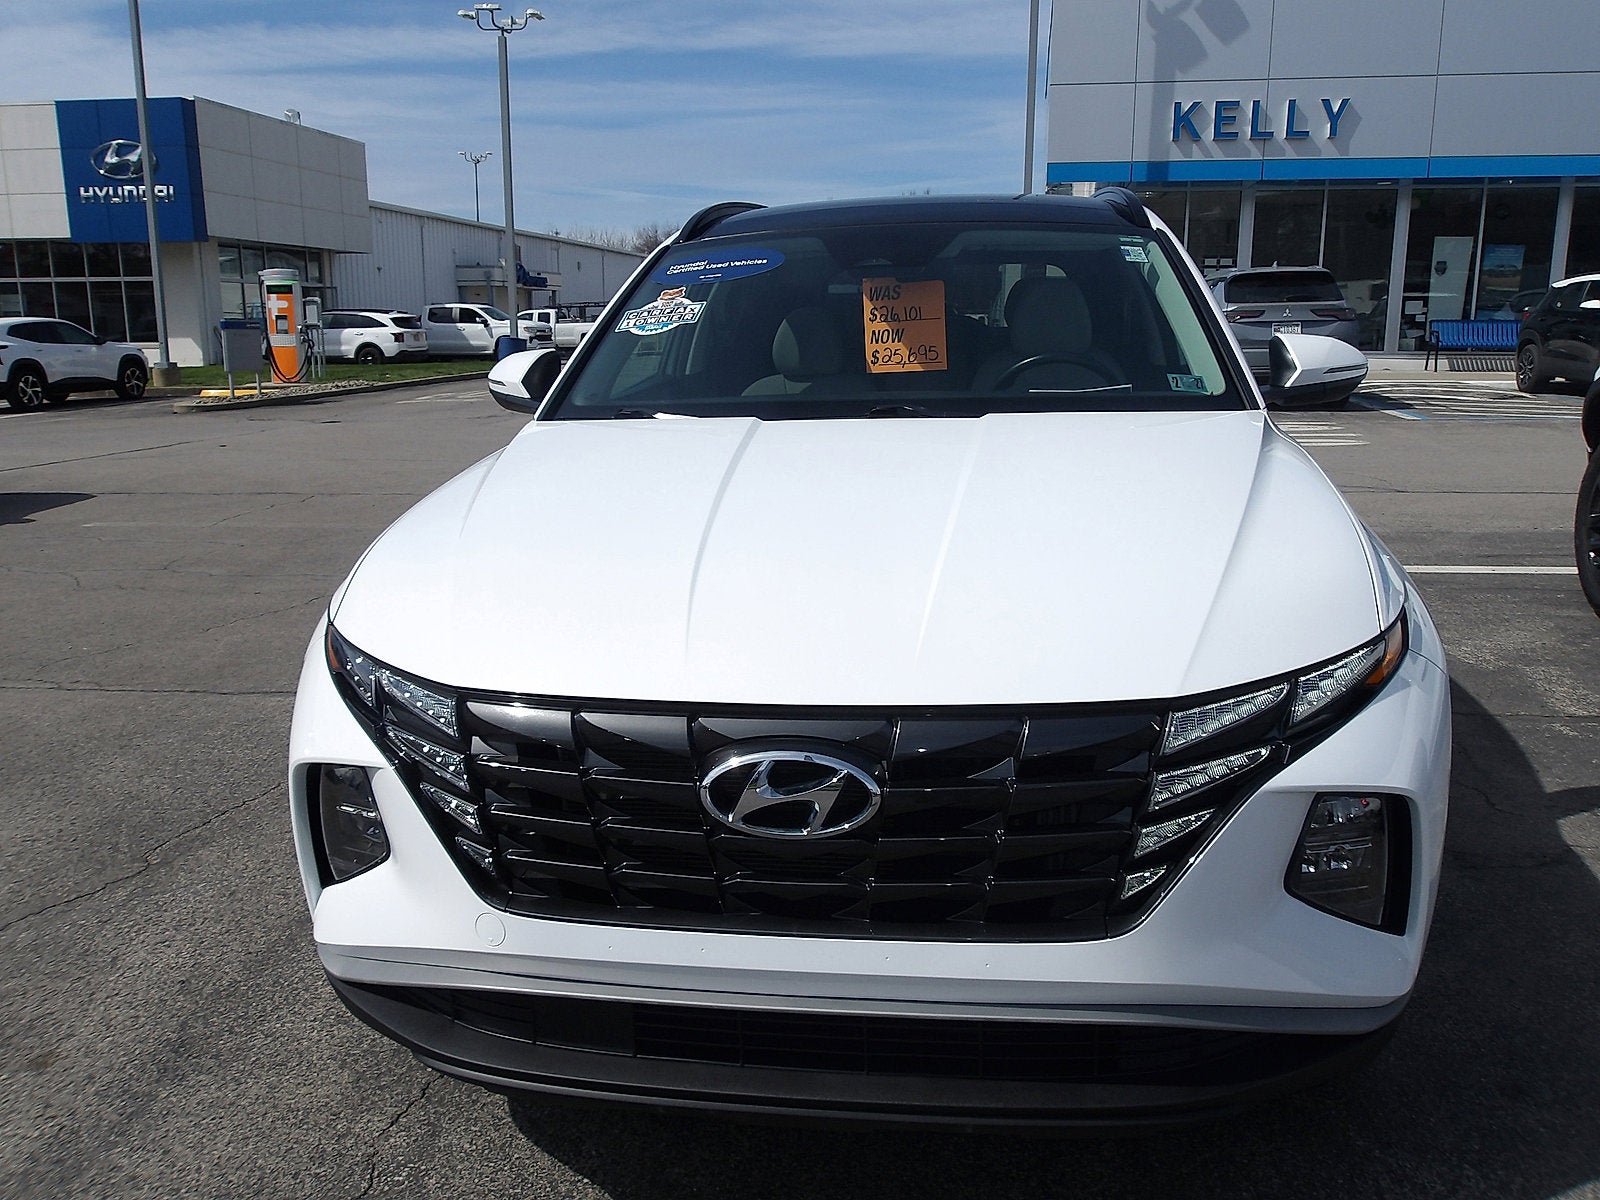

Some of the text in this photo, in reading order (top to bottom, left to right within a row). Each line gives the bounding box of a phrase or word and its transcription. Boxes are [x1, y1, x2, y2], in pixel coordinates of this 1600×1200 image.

[1172, 98, 1351, 141] KELLY
[667, 259, 768, 275] Certified Used Vehicles
[670, 260, 708, 270] Hyundai
[869, 284, 902, 302] WAS
[628, 305, 698, 319] CARFAX
[634, 312, 695, 326] OWNER
[869, 305, 923, 324] $26,101
[870, 328, 905, 345] NOW
[870, 345, 940, 368] $25,695
